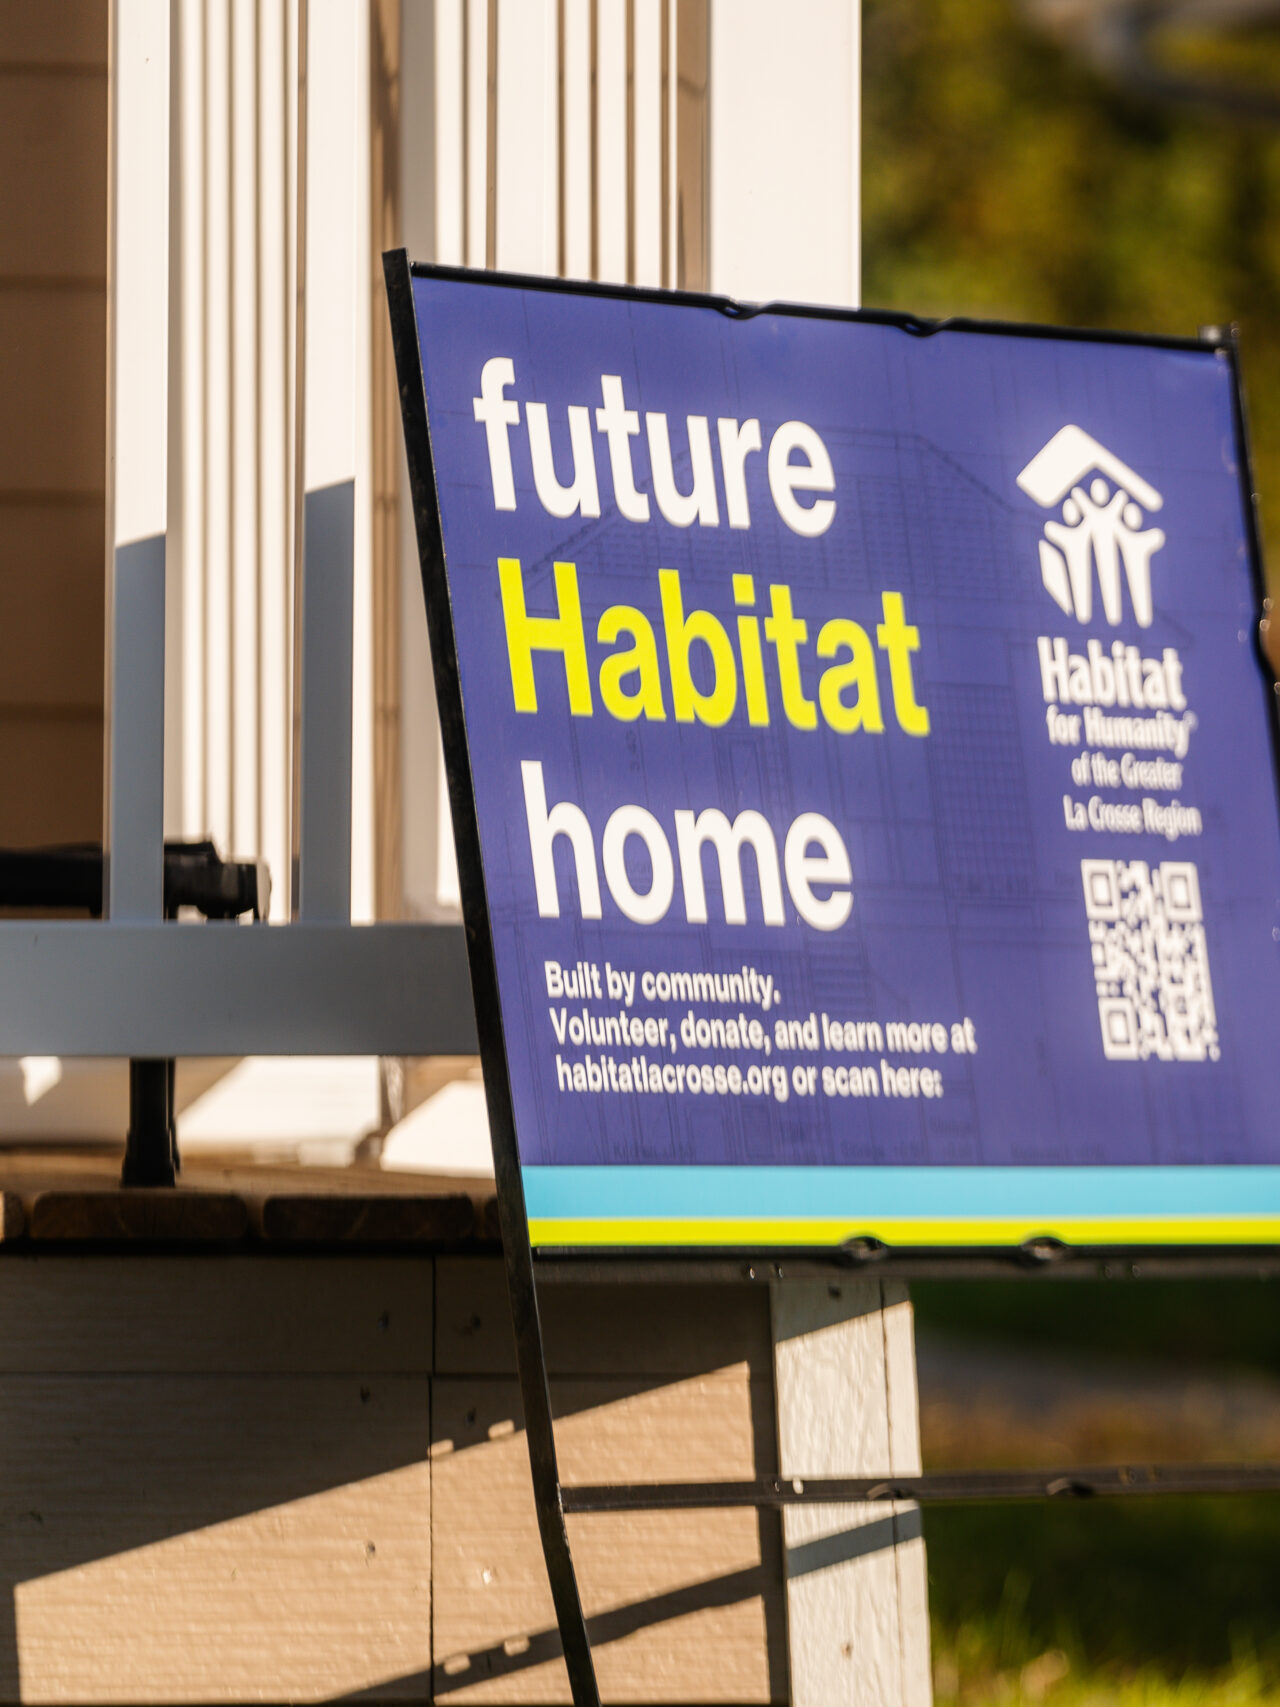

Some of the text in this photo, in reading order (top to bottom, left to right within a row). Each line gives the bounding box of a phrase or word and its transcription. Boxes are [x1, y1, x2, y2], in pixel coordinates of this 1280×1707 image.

[473, 357, 836, 537] future
[497, 557, 930, 737] Habitat
[1038, 636, 1186, 710] Habitat
[1046, 704, 1081, 746] for
[1071, 750, 1183, 790] of the Greater
[1063, 794, 1202, 841] La Crosse Region
[521, 760, 853, 931] home
[544, 961, 781, 1011] Built by community.
[549, 1008, 977, 1055] Volunteer, donate, and learn more at
[555, 1054, 944, 1103] habitatlacrosse.org or scan here:
